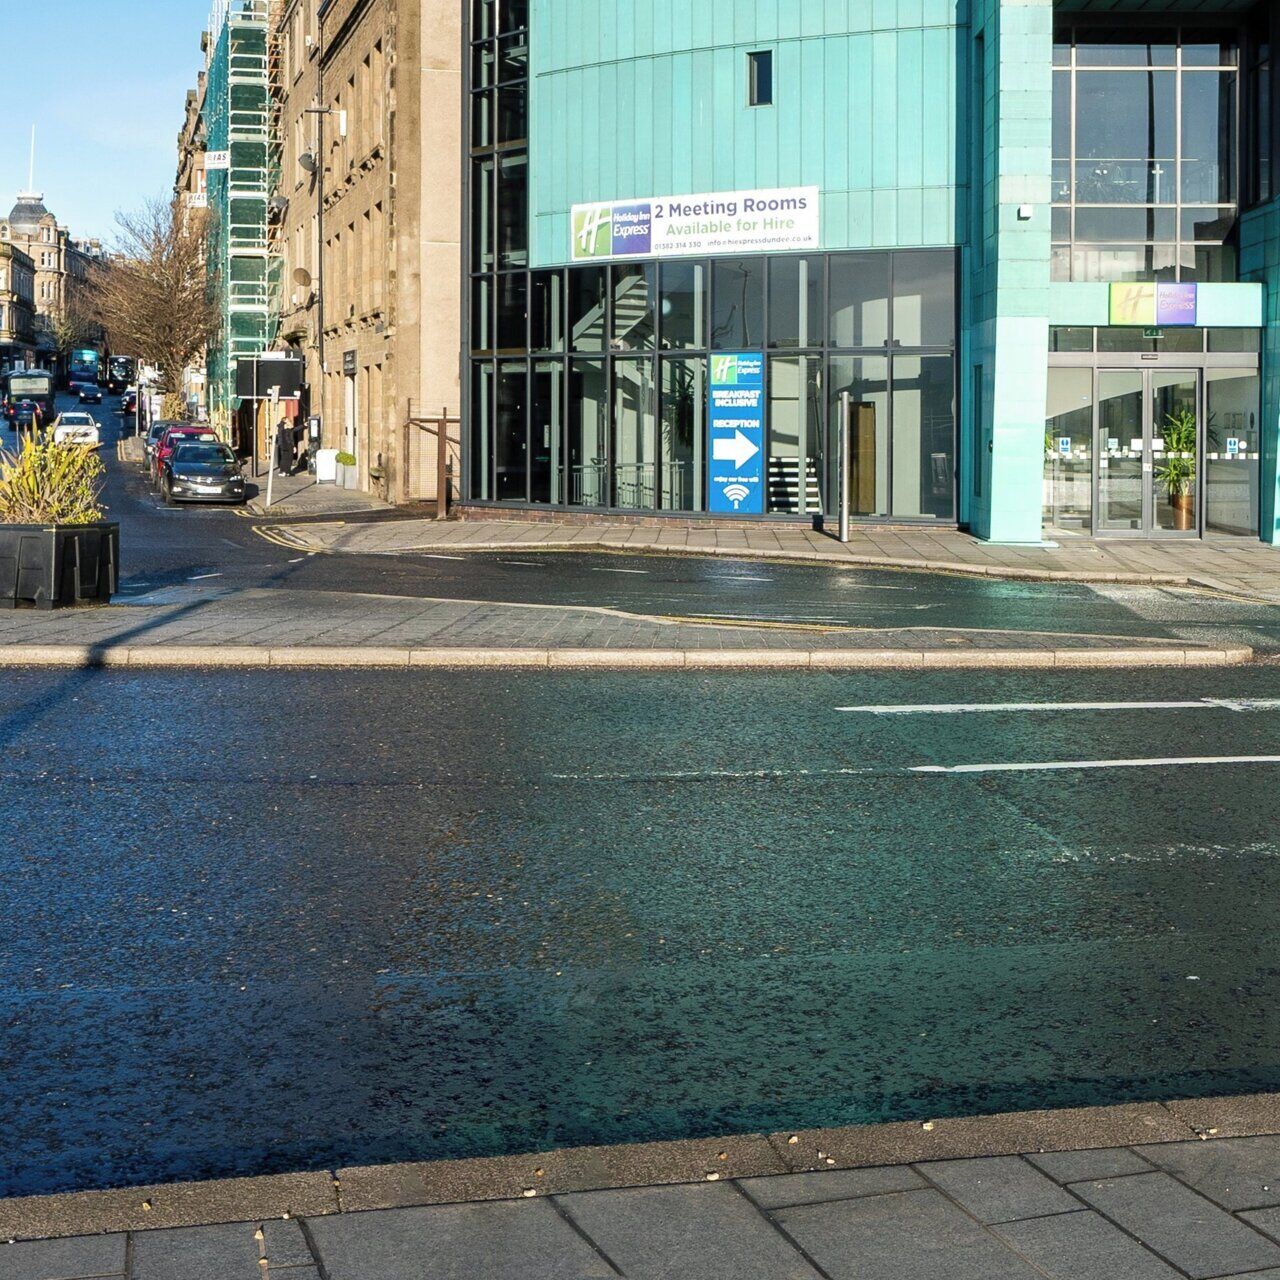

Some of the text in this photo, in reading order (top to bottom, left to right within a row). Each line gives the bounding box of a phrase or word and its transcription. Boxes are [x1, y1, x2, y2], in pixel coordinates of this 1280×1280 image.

[654, 197, 807, 219] 2 Meeting Rooms
[613, 211, 650, 223] Holiday Inn
[613, 224, 649, 238] Express
[665, 217, 795, 236] Available for Hire
[737, 367, 761, 375] Express
[712, 390, 761, 399] BREAKFAST
[714, 398, 758, 407] INCLUSIVE
[712, 419, 760, 428] RECEPTION
